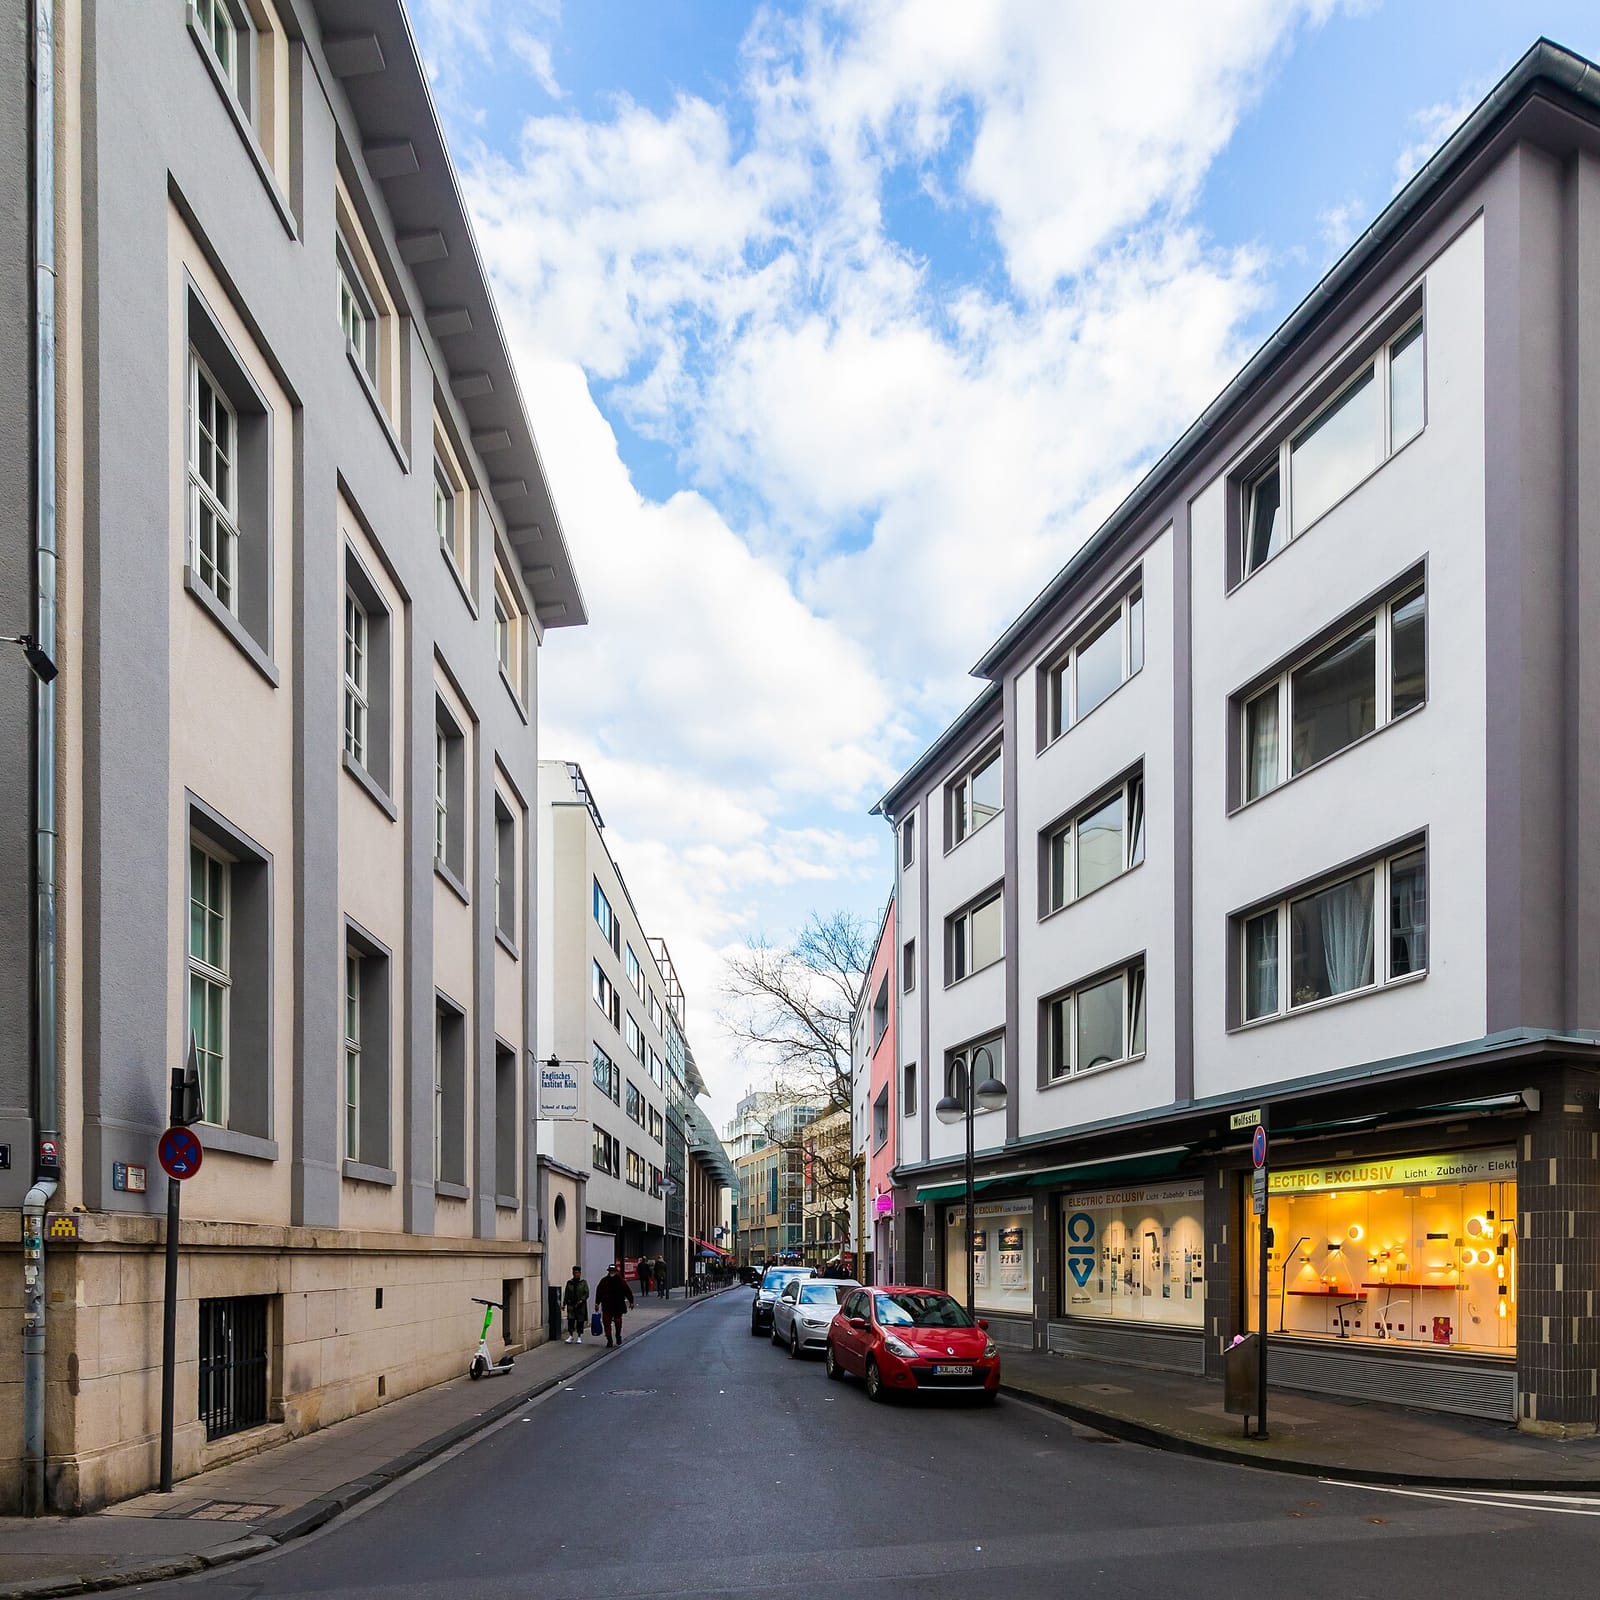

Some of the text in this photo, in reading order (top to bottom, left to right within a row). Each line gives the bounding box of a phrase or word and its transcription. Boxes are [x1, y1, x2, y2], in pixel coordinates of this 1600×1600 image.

[541, 1071, 570, 1081] Englisches
[541, 1079, 563, 1088] Institut
[1268, 1172, 1320, 1189] LECTRIC
[1325, 1166, 1394, 1185] EXCLUSIV
[1404, 1169, 1427, 1179] Licht
[1436, 1163, 1479, 1176] Zubehör
[1068, 1196, 1104, 1208] ELECTRIC
[1105, 1191, 1145, 1205] EXCLUSIV
[713, 1227, 722, 1239] P
